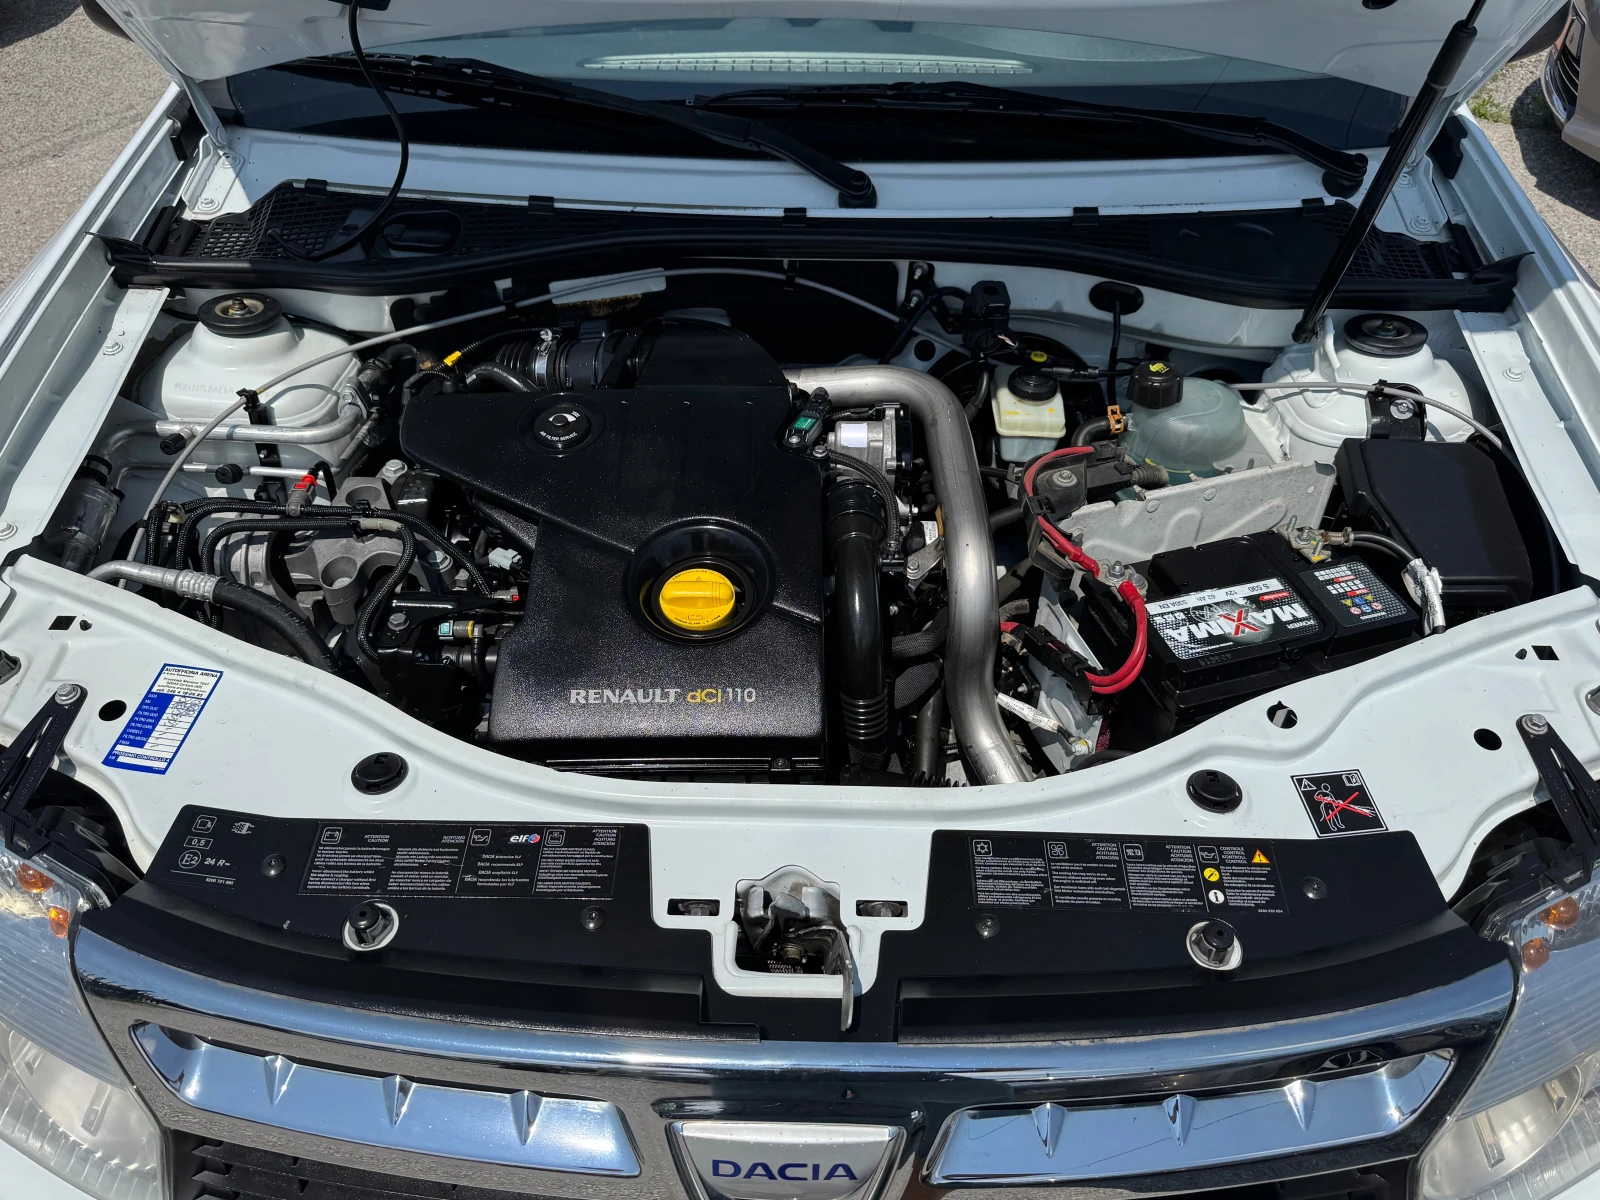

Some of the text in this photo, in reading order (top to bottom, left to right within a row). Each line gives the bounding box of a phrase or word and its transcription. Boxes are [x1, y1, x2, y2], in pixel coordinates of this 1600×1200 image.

[1166, 602, 1309, 642] MAXIMA
[1286, 620, 1316, 629] POWER
[570, 688, 680, 703] RENAULT
[726, 688, 756, 702] 110
[191, 839, 205, 847] 0,5
[712, 1159, 858, 1180] DACIA
